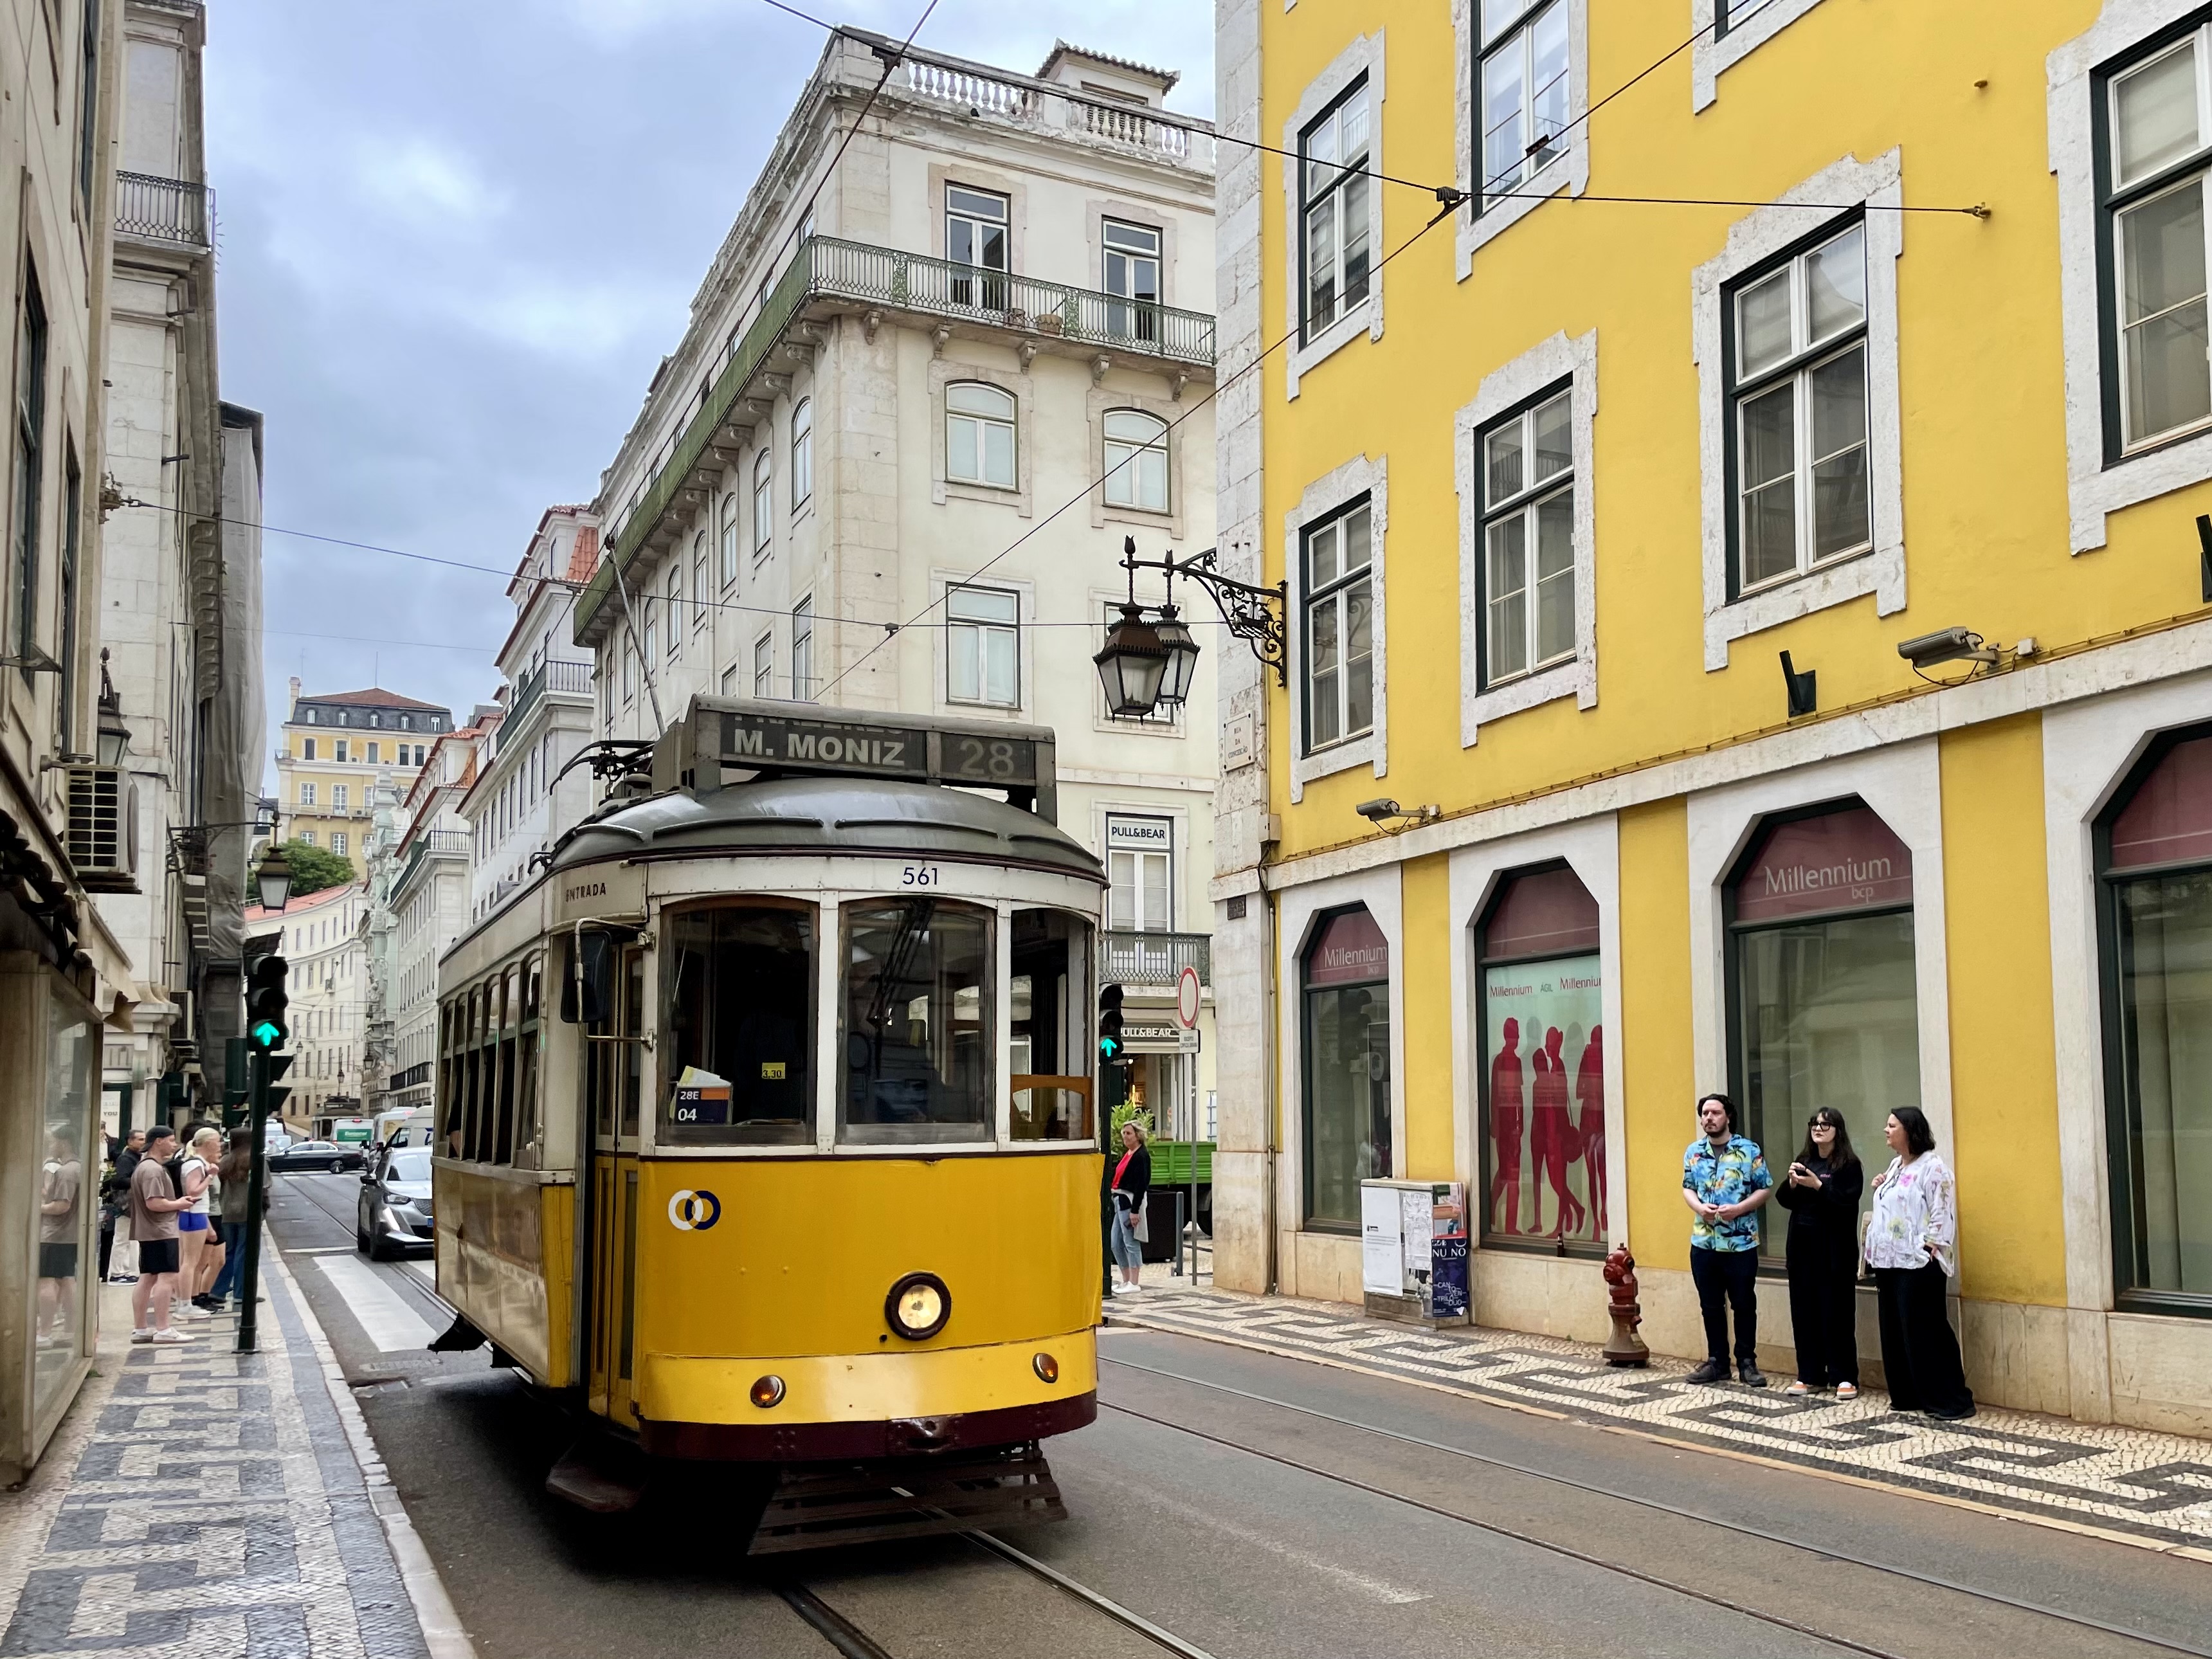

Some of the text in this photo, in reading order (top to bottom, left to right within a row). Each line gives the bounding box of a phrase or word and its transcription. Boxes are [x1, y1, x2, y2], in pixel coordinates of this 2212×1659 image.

[734, 729, 905, 766] M. MONIZ
[960, 738, 1015, 777] 28
[1112, 826, 1165, 839] PULL&BEAR
[902, 867, 938, 885] 561
[1764, 857, 1890, 896] Millennium
[565, 882, 606, 902] ENTRADA
[1851, 885, 1873, 903] bcp
[1325, 944, 1388, 968] Millennium
[1490, 984, 1533, 999] Millennium
[680, 1091, 700, 1100] 28E
[678, 1108, 698, 1121] 04
